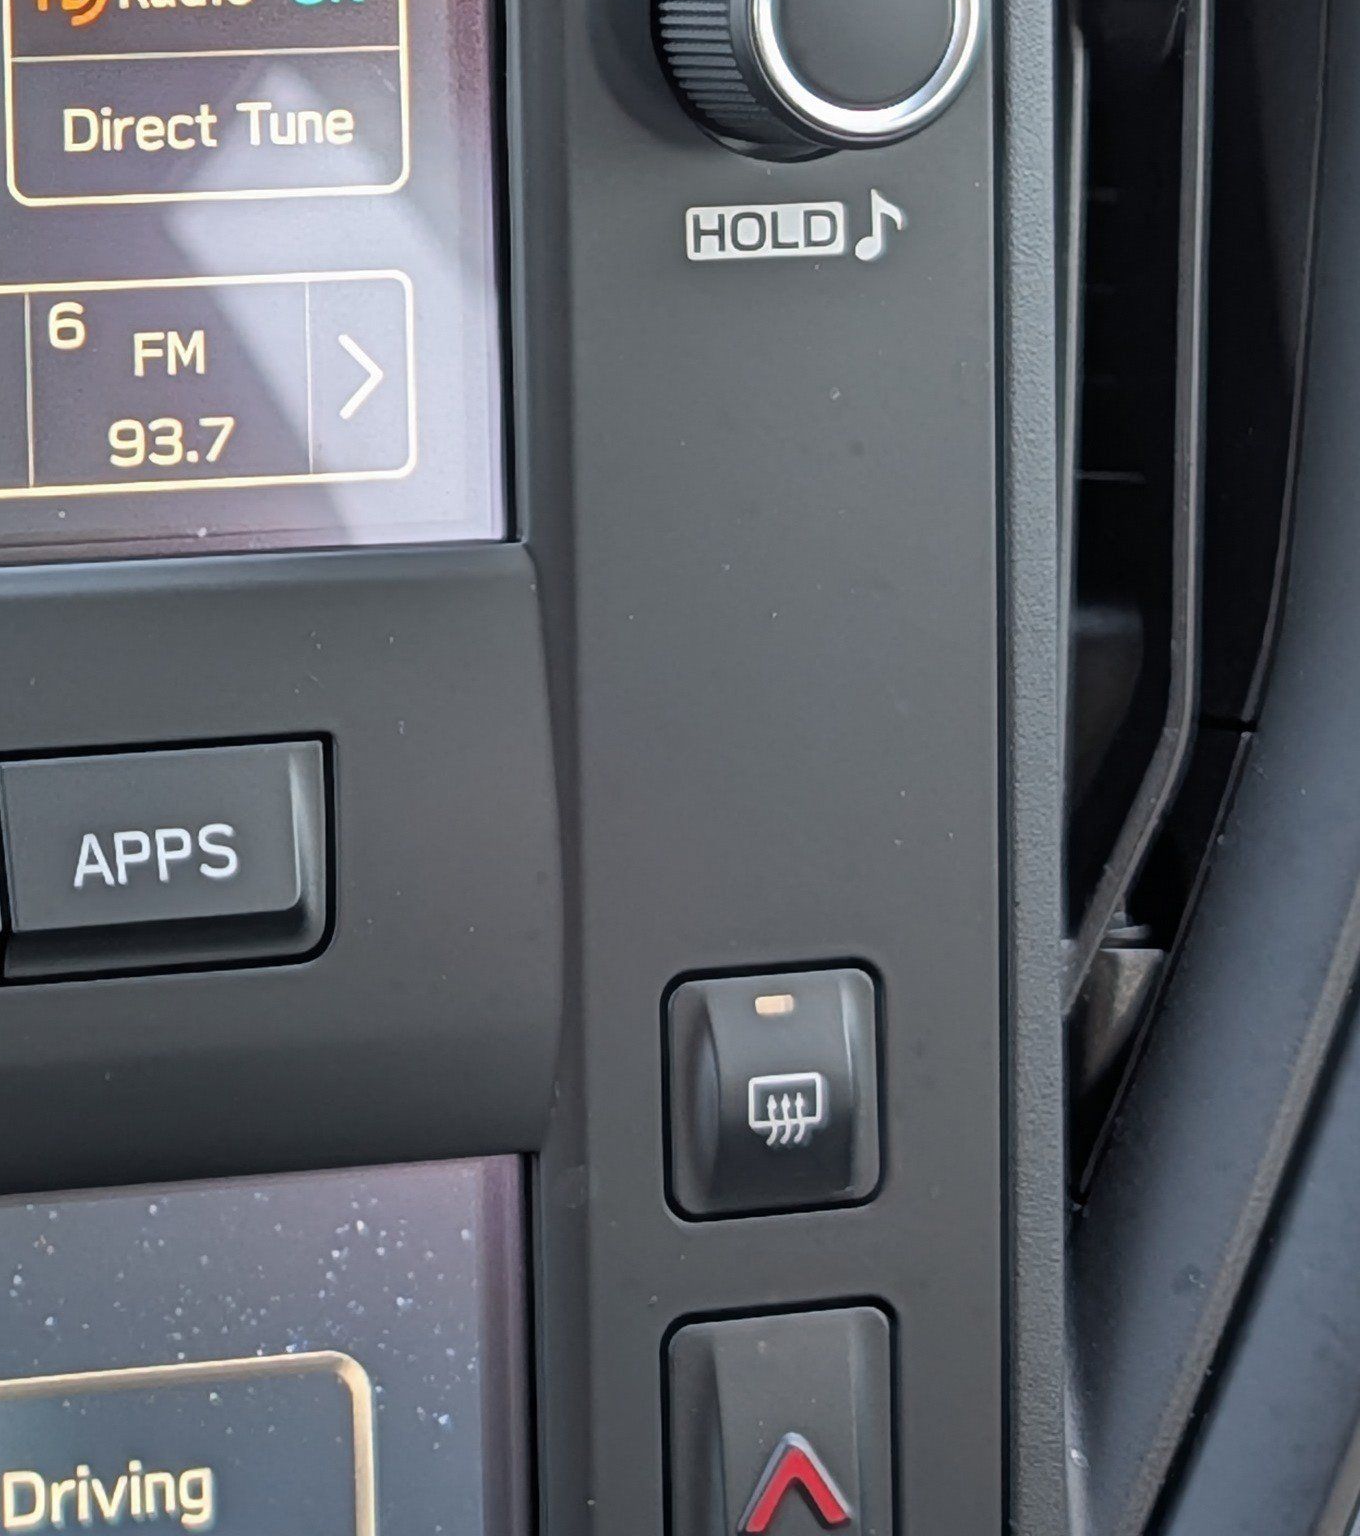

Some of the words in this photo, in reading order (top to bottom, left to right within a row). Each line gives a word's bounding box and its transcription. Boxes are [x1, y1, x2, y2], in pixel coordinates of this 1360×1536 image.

[63, 104, 218, 153] Direct
[236, 100, 355, 149] Tune
[691, 209, 840, 255] HOLD
[49, 302, 85, 349] 6
[134, 330, 205, 376] FM
[109, 417, 235, 467] 93.7
[74, 824, 238, 887] APPS
[3, 1460, 213, 1529] Driving
